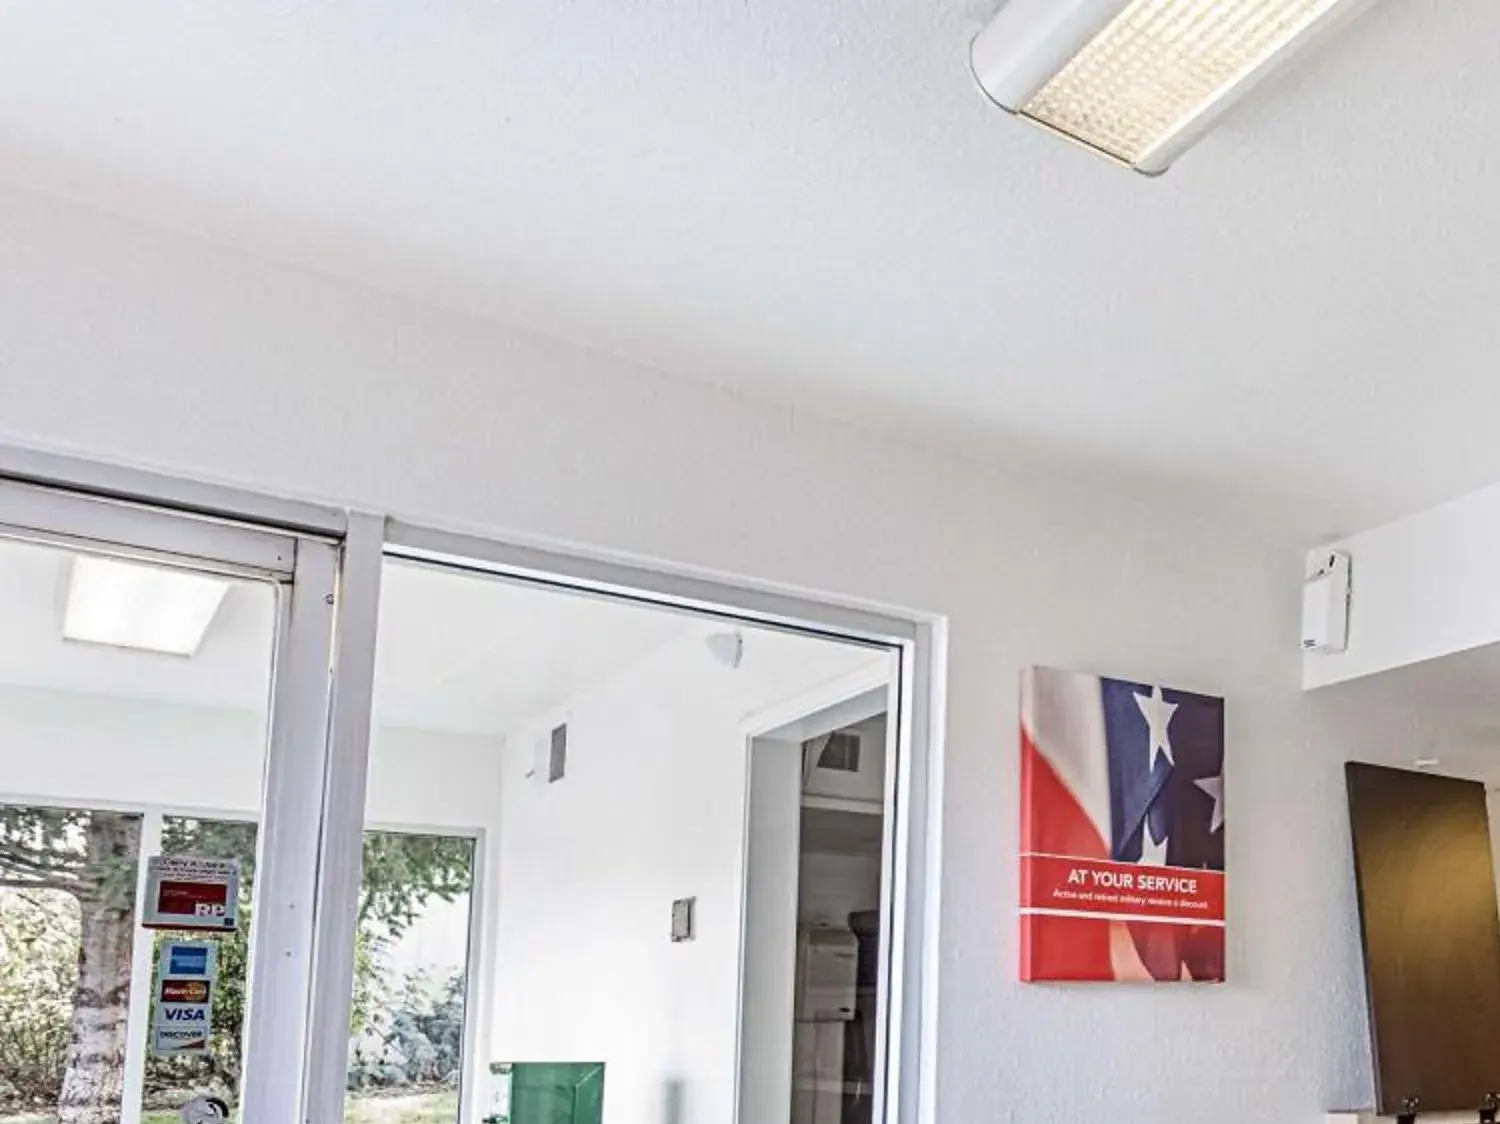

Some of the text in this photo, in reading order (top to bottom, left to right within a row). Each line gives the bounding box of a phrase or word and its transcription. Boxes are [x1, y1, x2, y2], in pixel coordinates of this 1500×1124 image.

[1067, 867, 1198, 894] AT YOUR SERVICE
[1053, 888, 1078, 899] Active
[1079, 891, 1092, 901] and
[1094, 892, 1118, 903] retired
[1119, 894, 1146, 907] military
[1179, 899, 1208, 910] discount
[165, 1008, 205, 1021] VISA
